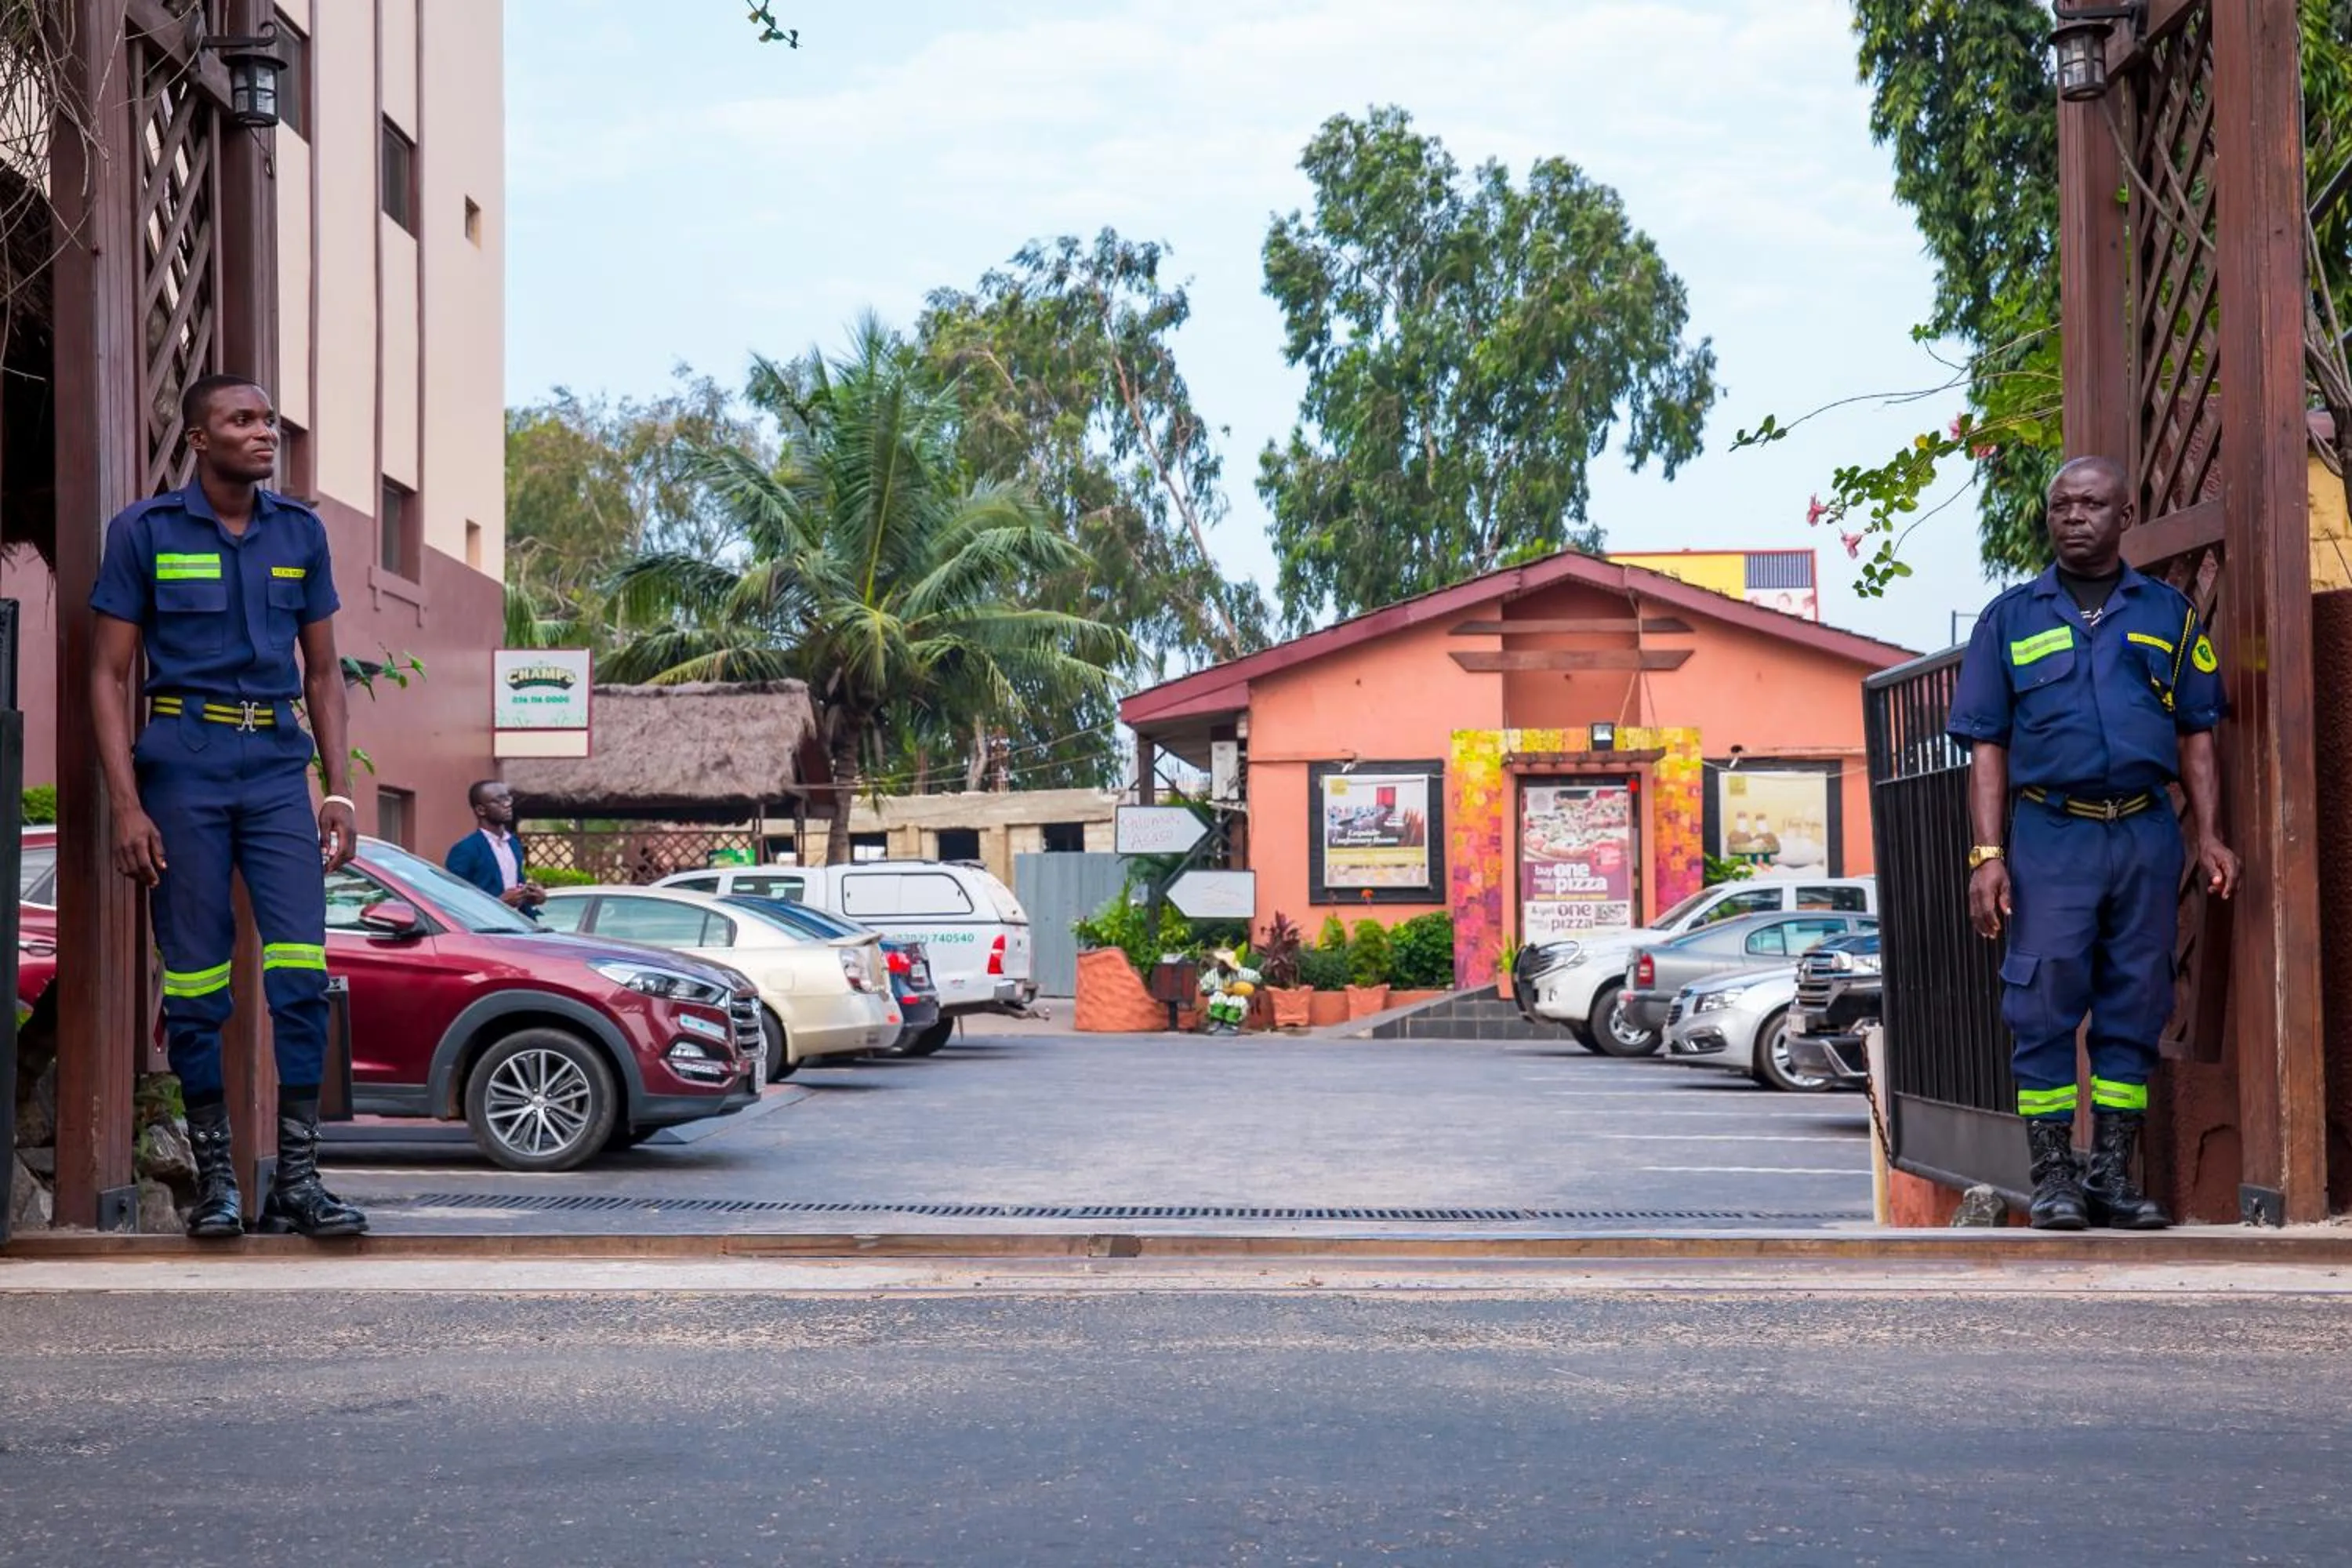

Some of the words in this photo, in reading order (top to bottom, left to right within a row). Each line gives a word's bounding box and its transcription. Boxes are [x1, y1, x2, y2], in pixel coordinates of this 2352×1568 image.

[506, 666, 577, 684] CHAMPS
[1534, 865, 1555, 877] buy
[1554, 863, 1591, 877] one
[1555, 877, 1607, 895] pizza
[1557, 903, 1592, 917] one
[1551, 919, 1594, 933] pizza
[931, 932, 975, 942] 740540
